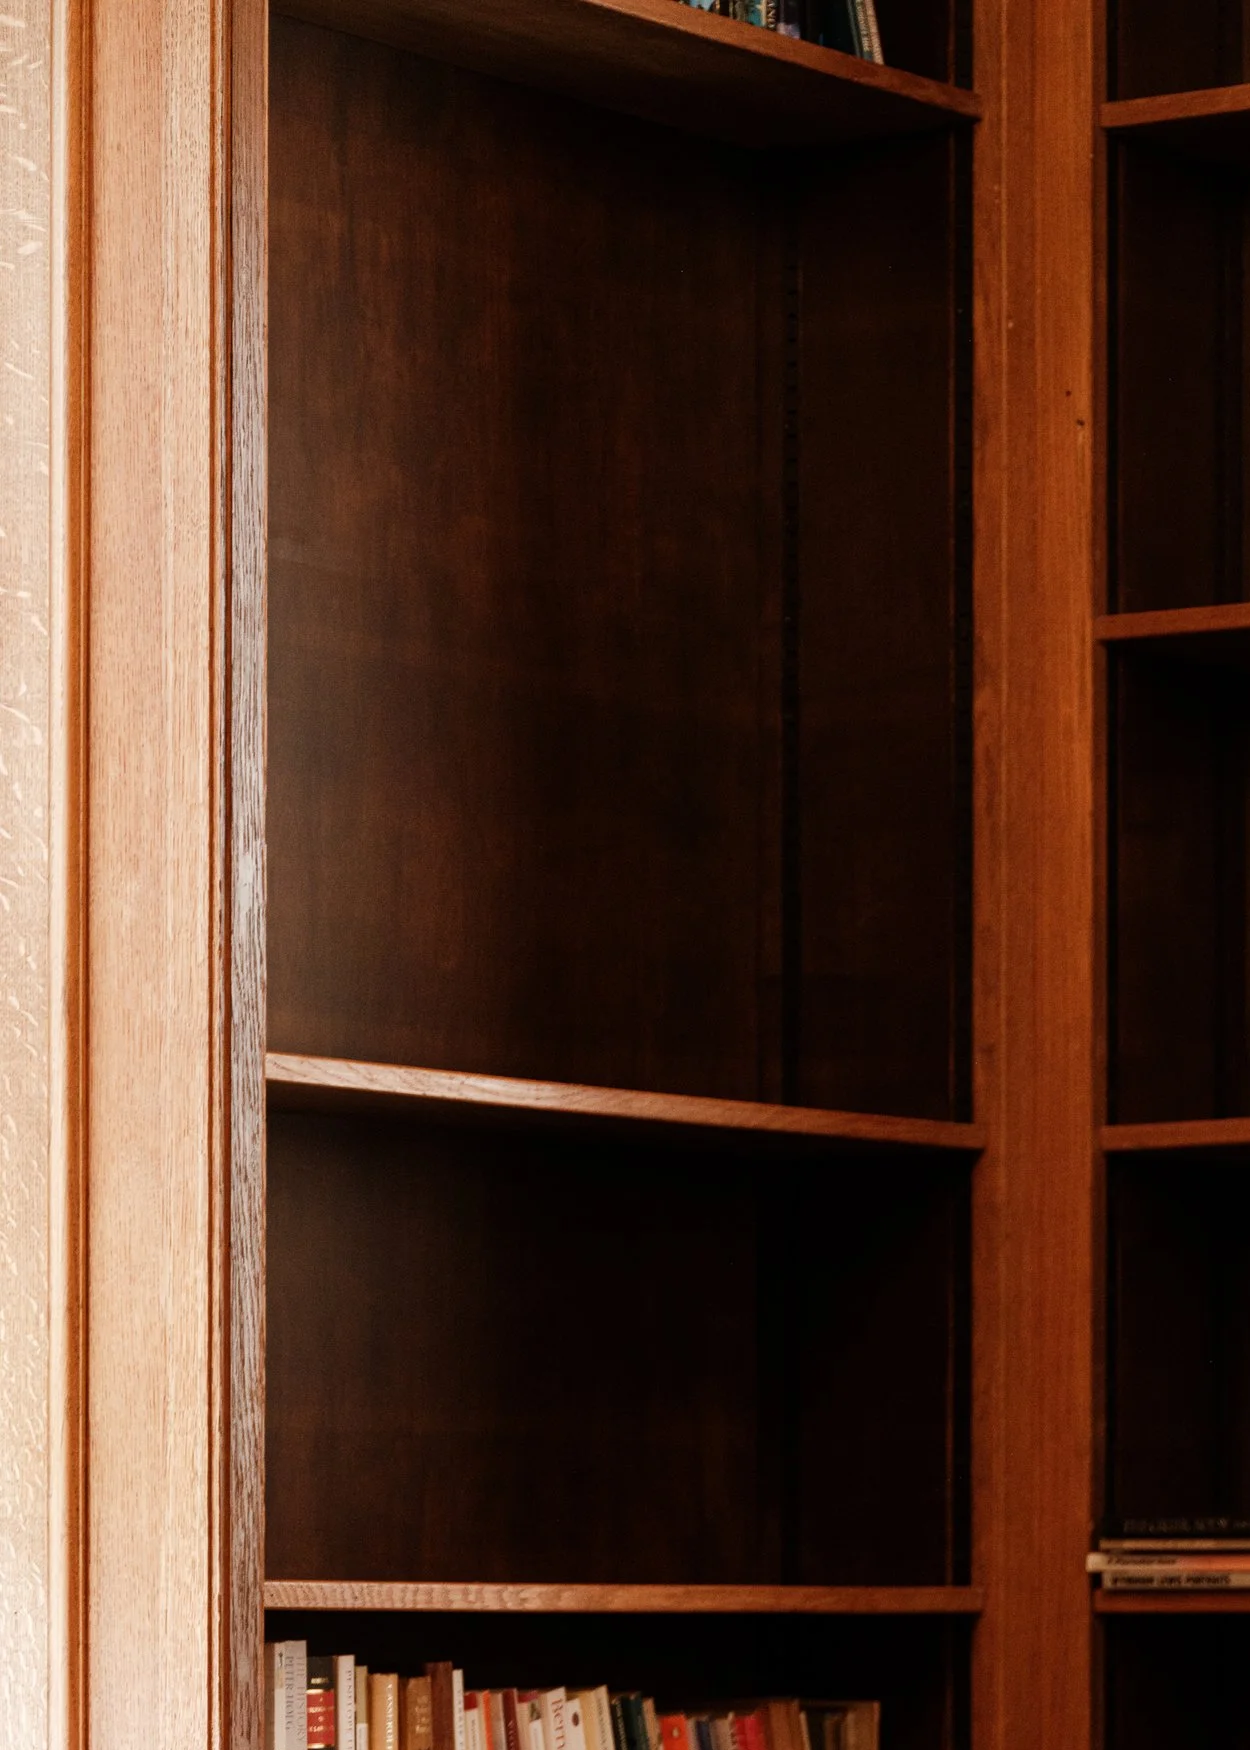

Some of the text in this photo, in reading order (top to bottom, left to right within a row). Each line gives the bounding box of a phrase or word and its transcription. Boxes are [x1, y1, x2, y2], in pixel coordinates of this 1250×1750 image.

[285, 1656, 295, 1691] PETER
[296, 1656, 306, 1679] THE
[296, 1686, 307, 1742] HISTORY
